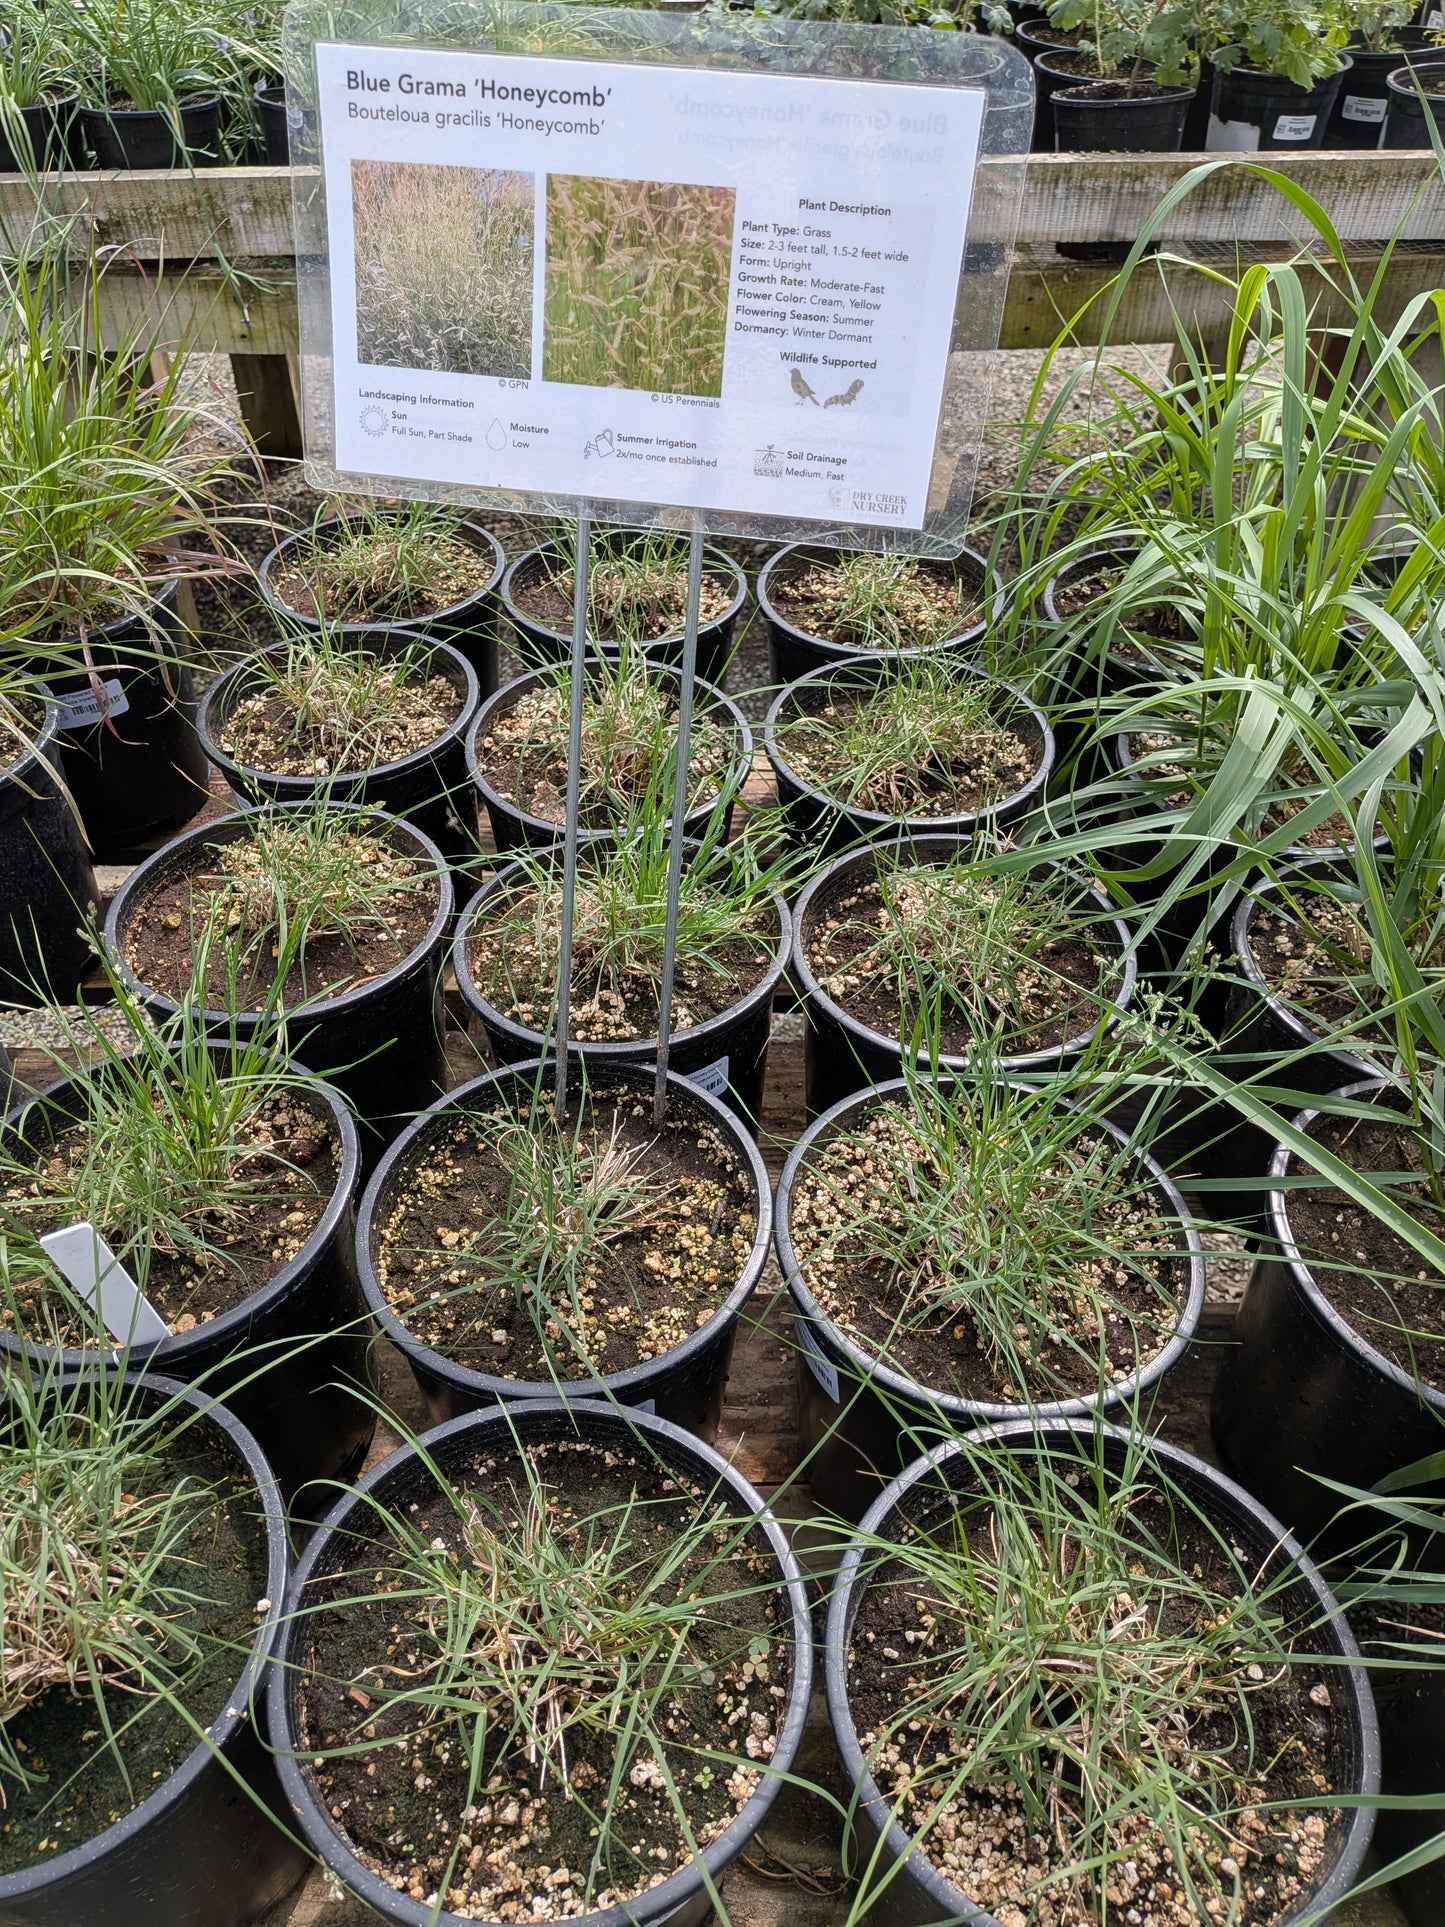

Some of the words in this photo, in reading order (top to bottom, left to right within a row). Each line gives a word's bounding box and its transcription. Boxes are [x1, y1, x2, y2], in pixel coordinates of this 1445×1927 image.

[346, 70, 391, 92] Blue
[397, 74, 466, 97] Grama
[474, 78, 612, 109] 'Honeycomb'
[349, 102, 430, 123] Bouteloua
[435, 107, 491, 128] gracilis
[496, 112, 605, 136] 'Honeycomb'
[798, 199, 826, 211] Plant
[829, 201, 891, 217] Description
[742, 221, 768, 233] Plant
[772, 223, 800, 237] Type:
[802, 226, 832, 238] Grass
[740, 238, 765, 250] Size:
[767, 240, 785, 252] 2-3
[787, 241, 808, 254] feet
[810, 244, 829, 257] tall,
[833, 246, 858, 258] 1.5-2
[861, 247, 881, 260] feet
[884, 250, 909, 262] wide
[739, 255, 770, 267] Form:
[773, 258, 812, 273] Upright
[738, 272, 777, 285] Growth
[780, 275, 807, 288] Rate:
[810, 278, 885, 295] Moderate-Fast
[737, 288, 772, 301] Flower
[775, 292, 807, 304] Color:
[809, 295, 845, 308] Cream,
[849, 298, 882, 311] Yellow
[735, 305, 786, 321] Flowering
[789, 310, 830, 323] Season:
[832, 313, 875, 327] Summer
[734, 321, 790, 337] Dormancy:
[792, 327, 825, 339] Winter
[828, 330, 873, 344] Dormant
[780, 351, 819, 364] Wildlife
[822, 355, 877, 370] Supported
[508, 380, 529, 390] GPN
[359, 388, 417, 405] Landscaping
[419, 394, 475, 409] Information
[661, 394, 674, 404] US
[675, 397, 721, 409] Perennials
[391, 411, 408, 420] Sun
[391, 426, 407, 436] Full
[408, 428, 427, 439] Sun,
[428, 430, 445, 440] Part
[447, 432, 473, 443] Shade
[509, 422, 549, 434] Moisture
[512, 439, 530, 448] Low
[617, 433, 654, 445] Summer
[655, 436, 697, 450] Irrigation
[616, 449, 644, 460] 2x/mo
[645, 454, 666, 463] once
[668, 455, 718, 467] established
[787, 451, 803, 460] Soil
[806, 452, 848, 466] Drainage
[785, 467, 824, 480] Medium,
[826, 471, 845, 481] Fast
[852, 491, 873, 501] DRY
[875, 493, 908, 505] CREEK
[851, 500, 908, 515] NURSERY
